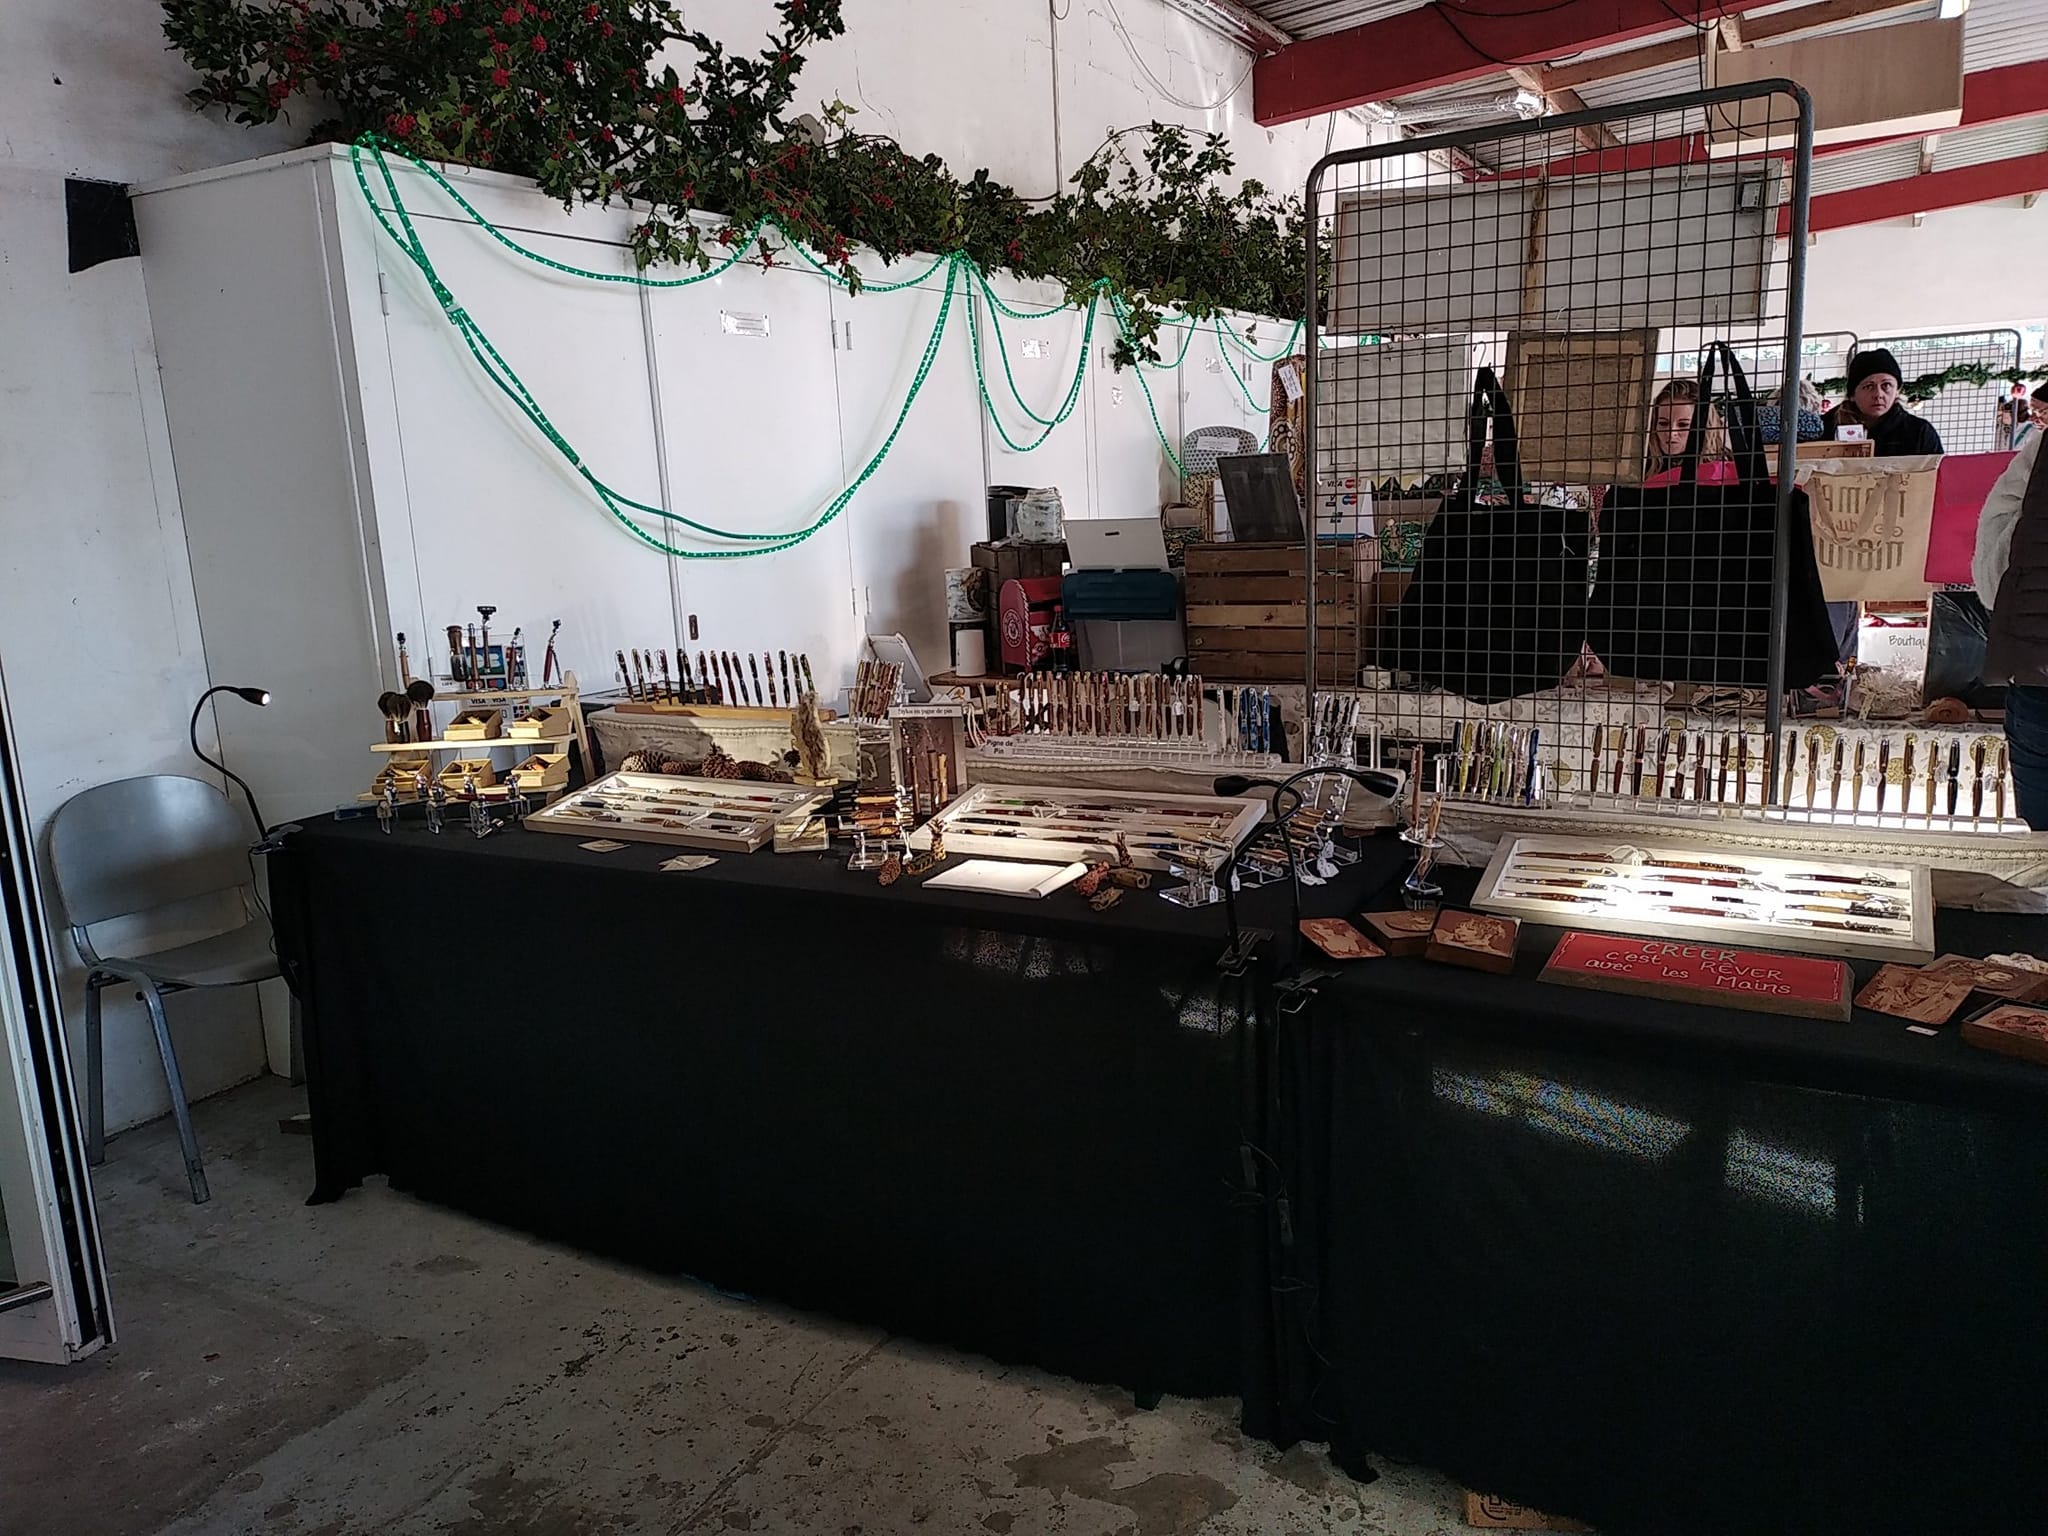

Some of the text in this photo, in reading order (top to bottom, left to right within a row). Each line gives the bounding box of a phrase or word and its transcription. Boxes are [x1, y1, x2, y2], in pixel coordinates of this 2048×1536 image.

[1605, 951, 1662, 965] c'est
[1584, 959, 1792, 994] avec les Mains
